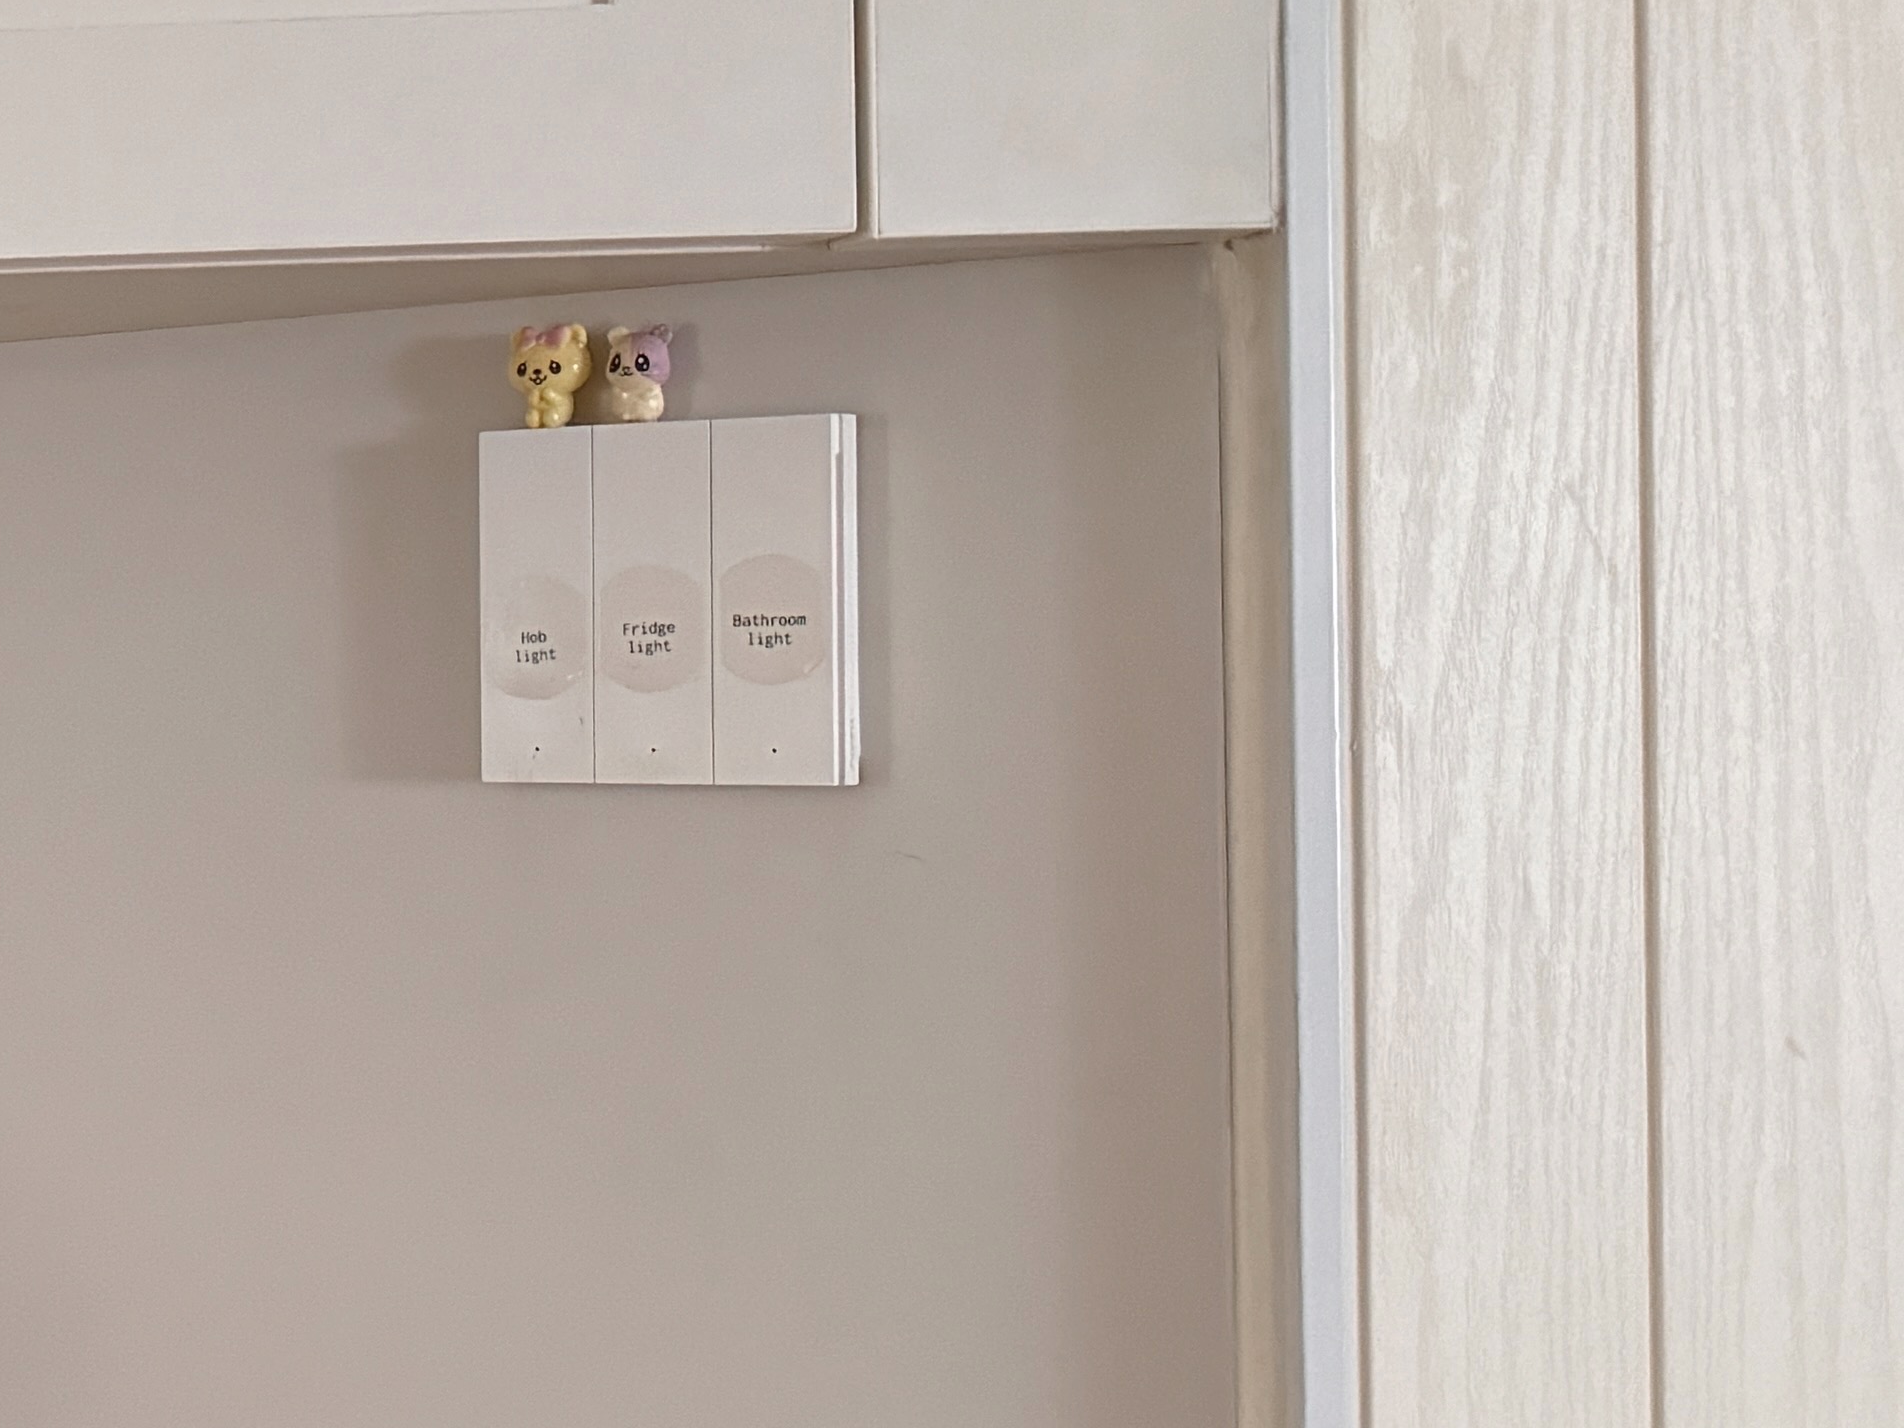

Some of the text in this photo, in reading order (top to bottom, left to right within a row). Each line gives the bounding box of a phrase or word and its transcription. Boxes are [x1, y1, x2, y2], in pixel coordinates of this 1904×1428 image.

[732, 612, 808, 628] Bathroom
[520, 630, 548, 645] Hob
[622, 620, 677, 639] Fridge
[628, 638, 673, 657] light
[747, 630, 794, 648] light
[515, 646, 557, 664] light
